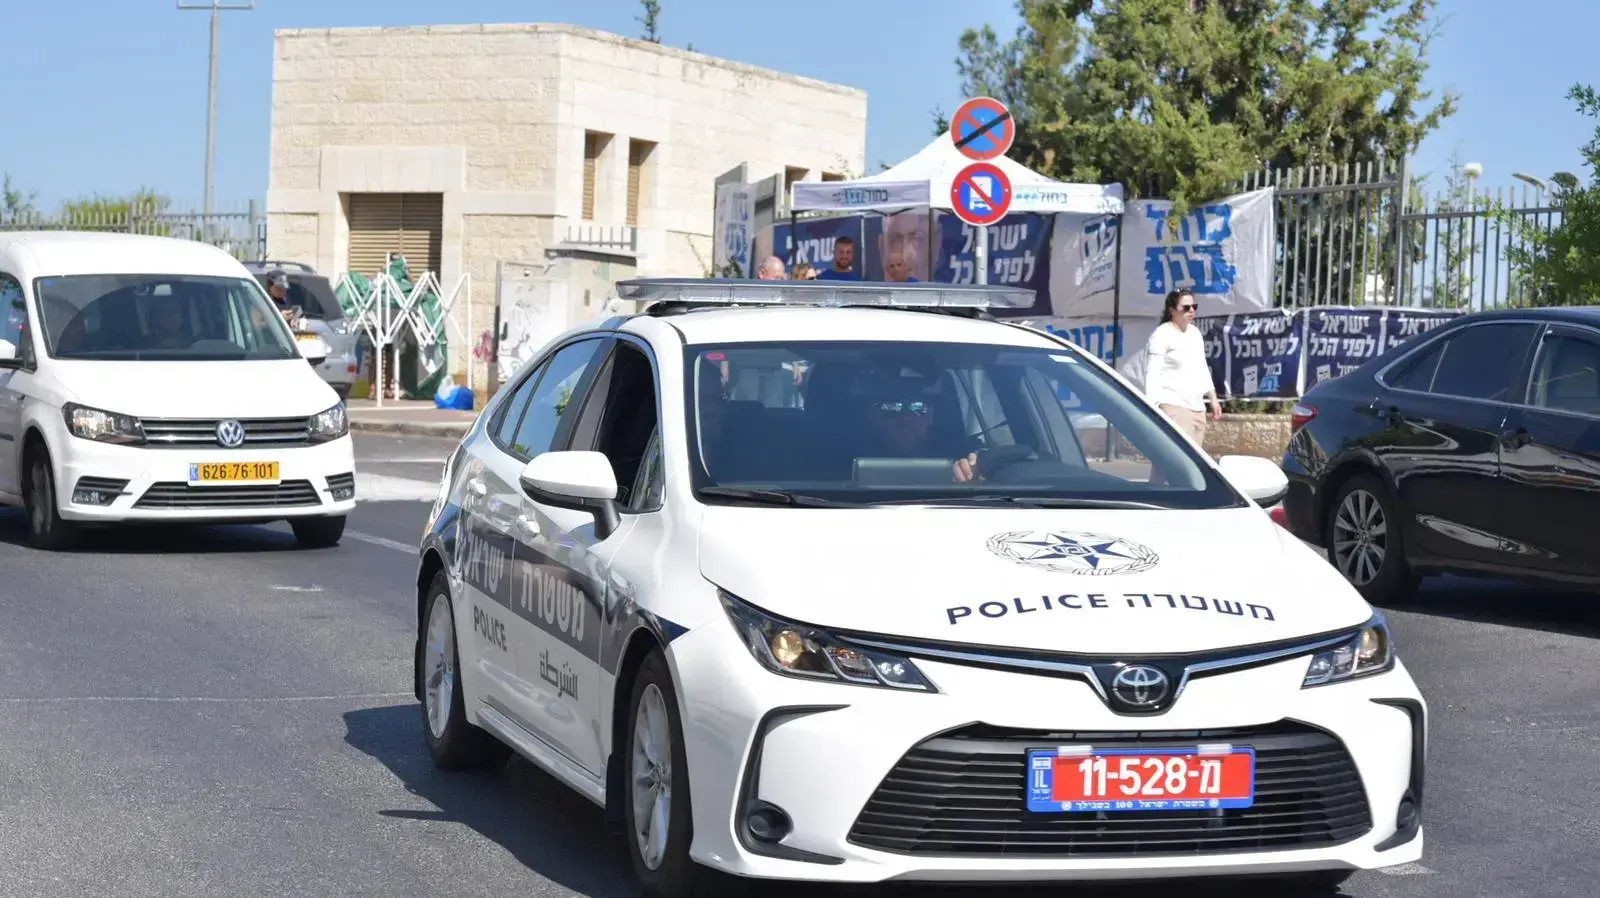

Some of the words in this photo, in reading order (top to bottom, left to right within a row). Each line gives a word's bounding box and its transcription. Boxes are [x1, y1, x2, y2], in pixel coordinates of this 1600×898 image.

[1146, 203, 1232, 242] כחל
[786, 236, 836, 265] שרא
[961, 223, 1028, 254] ישרל
[950, 254, 980, 285] כל
[994, 249, 1036, 284] לפני
[1240, 315, 1292, 335] ישראל
[1319, 311, 1369, 334] ישראל
[1231, 336, 1262, 359] הכל
[1267, 332, 1299, 356] לפני
[1310, 332, 1340, 357] הכל
[1342, 334, 1376, 358] לפני
[1337, 362, 1361, 378] חול
[520, 561, 585, 643] משטרת
[946, 594, 1109, 625] POLICE
[1123, 594, 1275, 622] משטרה
[473, 604, 507, 653] POLICE
[539, 649, 578, 700] الشرطة
[1034, 769, 1049, 788] IL
[1116, 801, 1132, 809] 100
